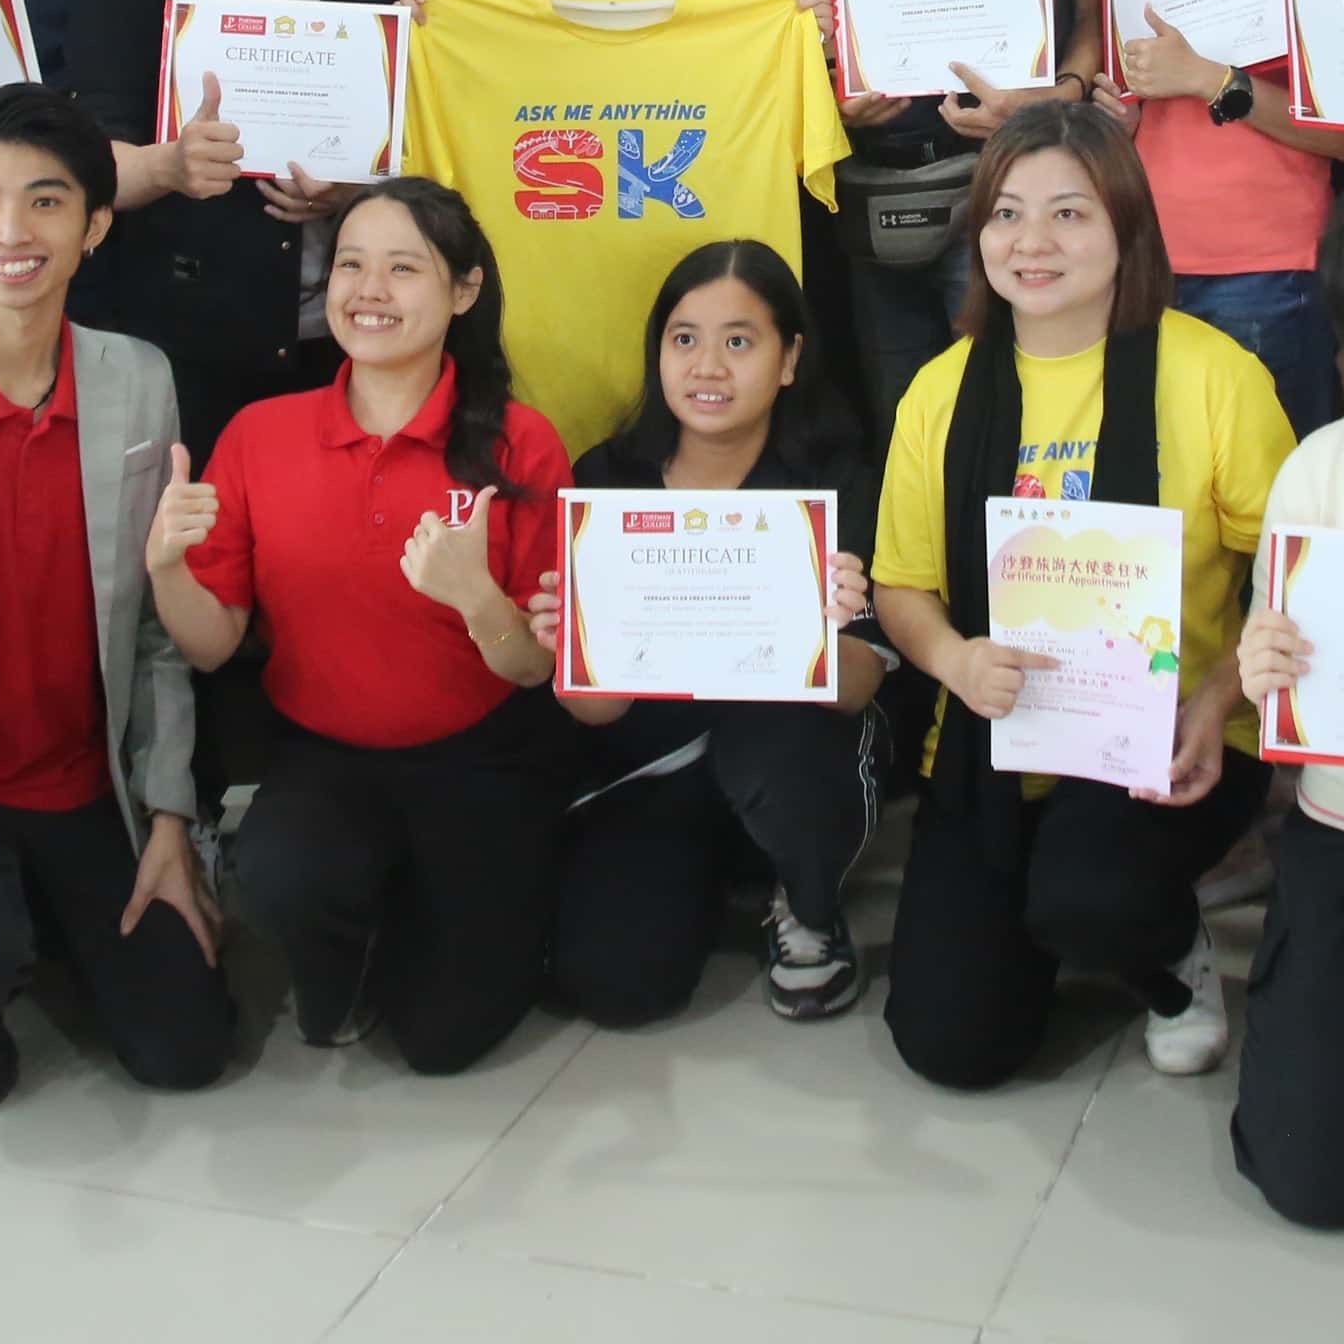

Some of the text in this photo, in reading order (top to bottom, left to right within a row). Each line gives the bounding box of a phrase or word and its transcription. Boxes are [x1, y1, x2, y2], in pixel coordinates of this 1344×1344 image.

[225, 46, 336, 66] CERTIFICATE
[514, 104, 556, 122] ASK
[564, 103, 593, 121] ME
[631, 547, 757, 565] CERTIFICATE
